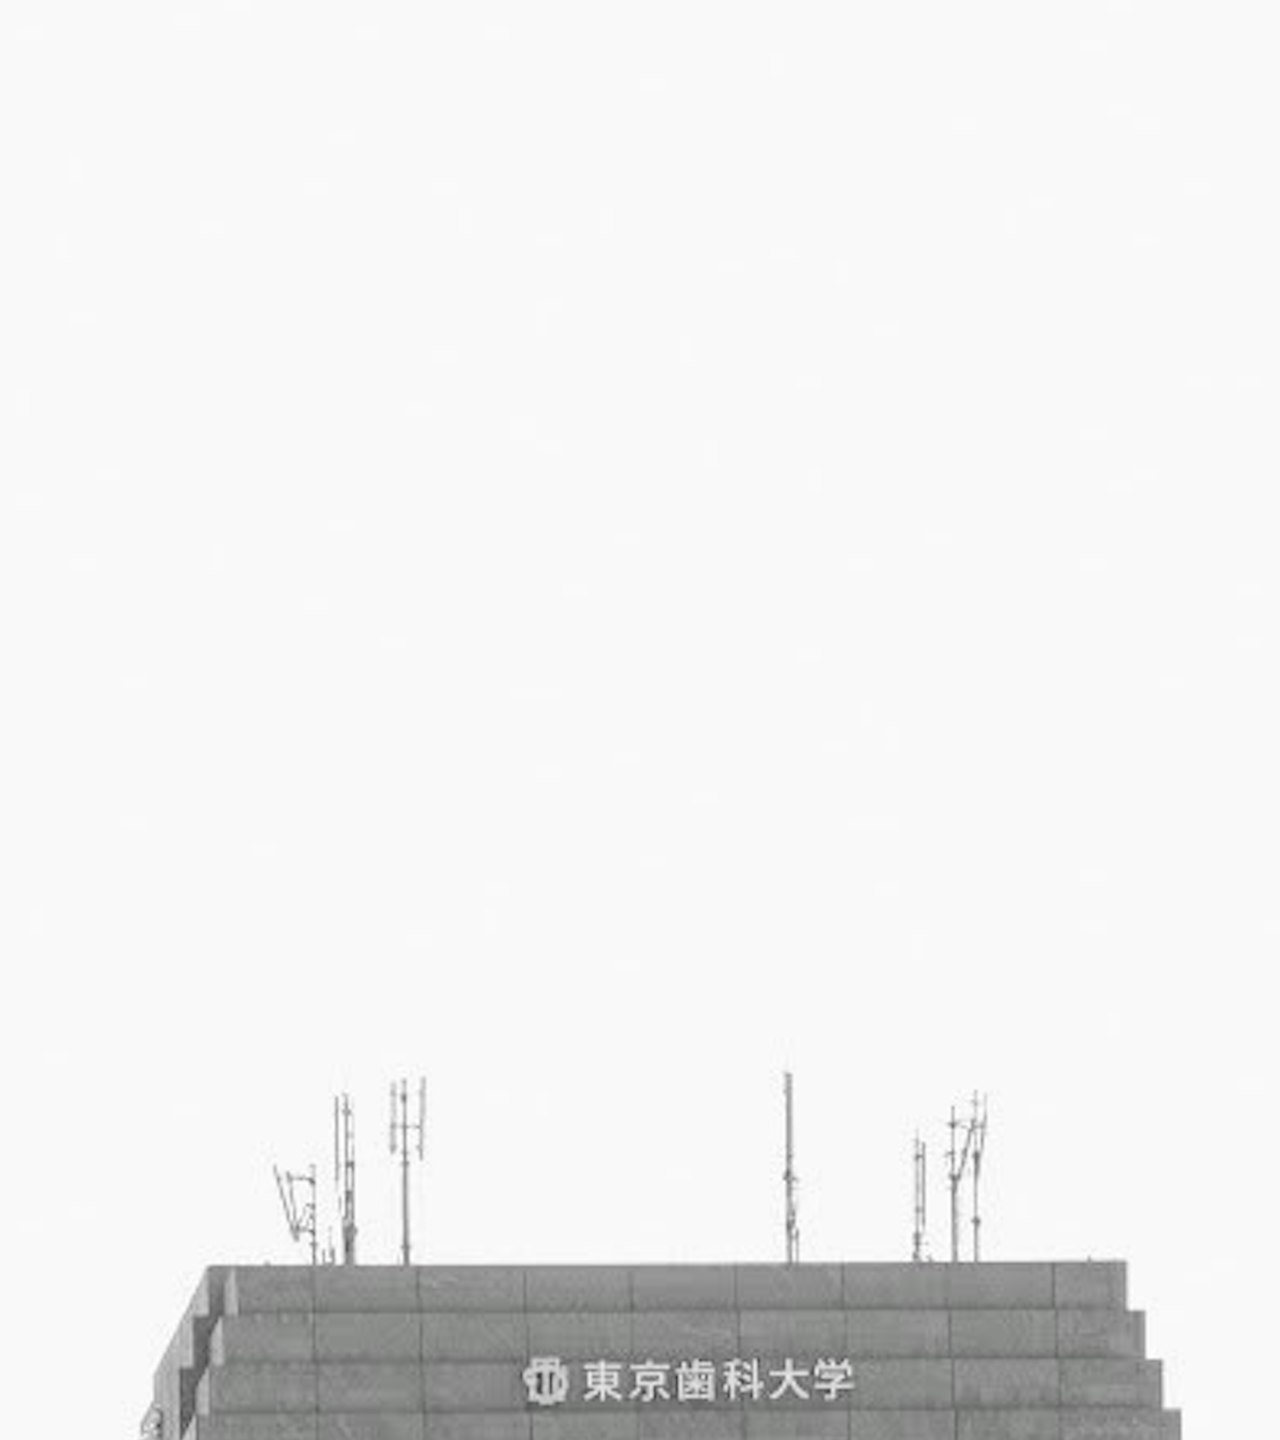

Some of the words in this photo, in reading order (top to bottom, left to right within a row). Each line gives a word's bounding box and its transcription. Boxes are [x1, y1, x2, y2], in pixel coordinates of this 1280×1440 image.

[583, 1358, 855, 1401] 東京歯科大学
